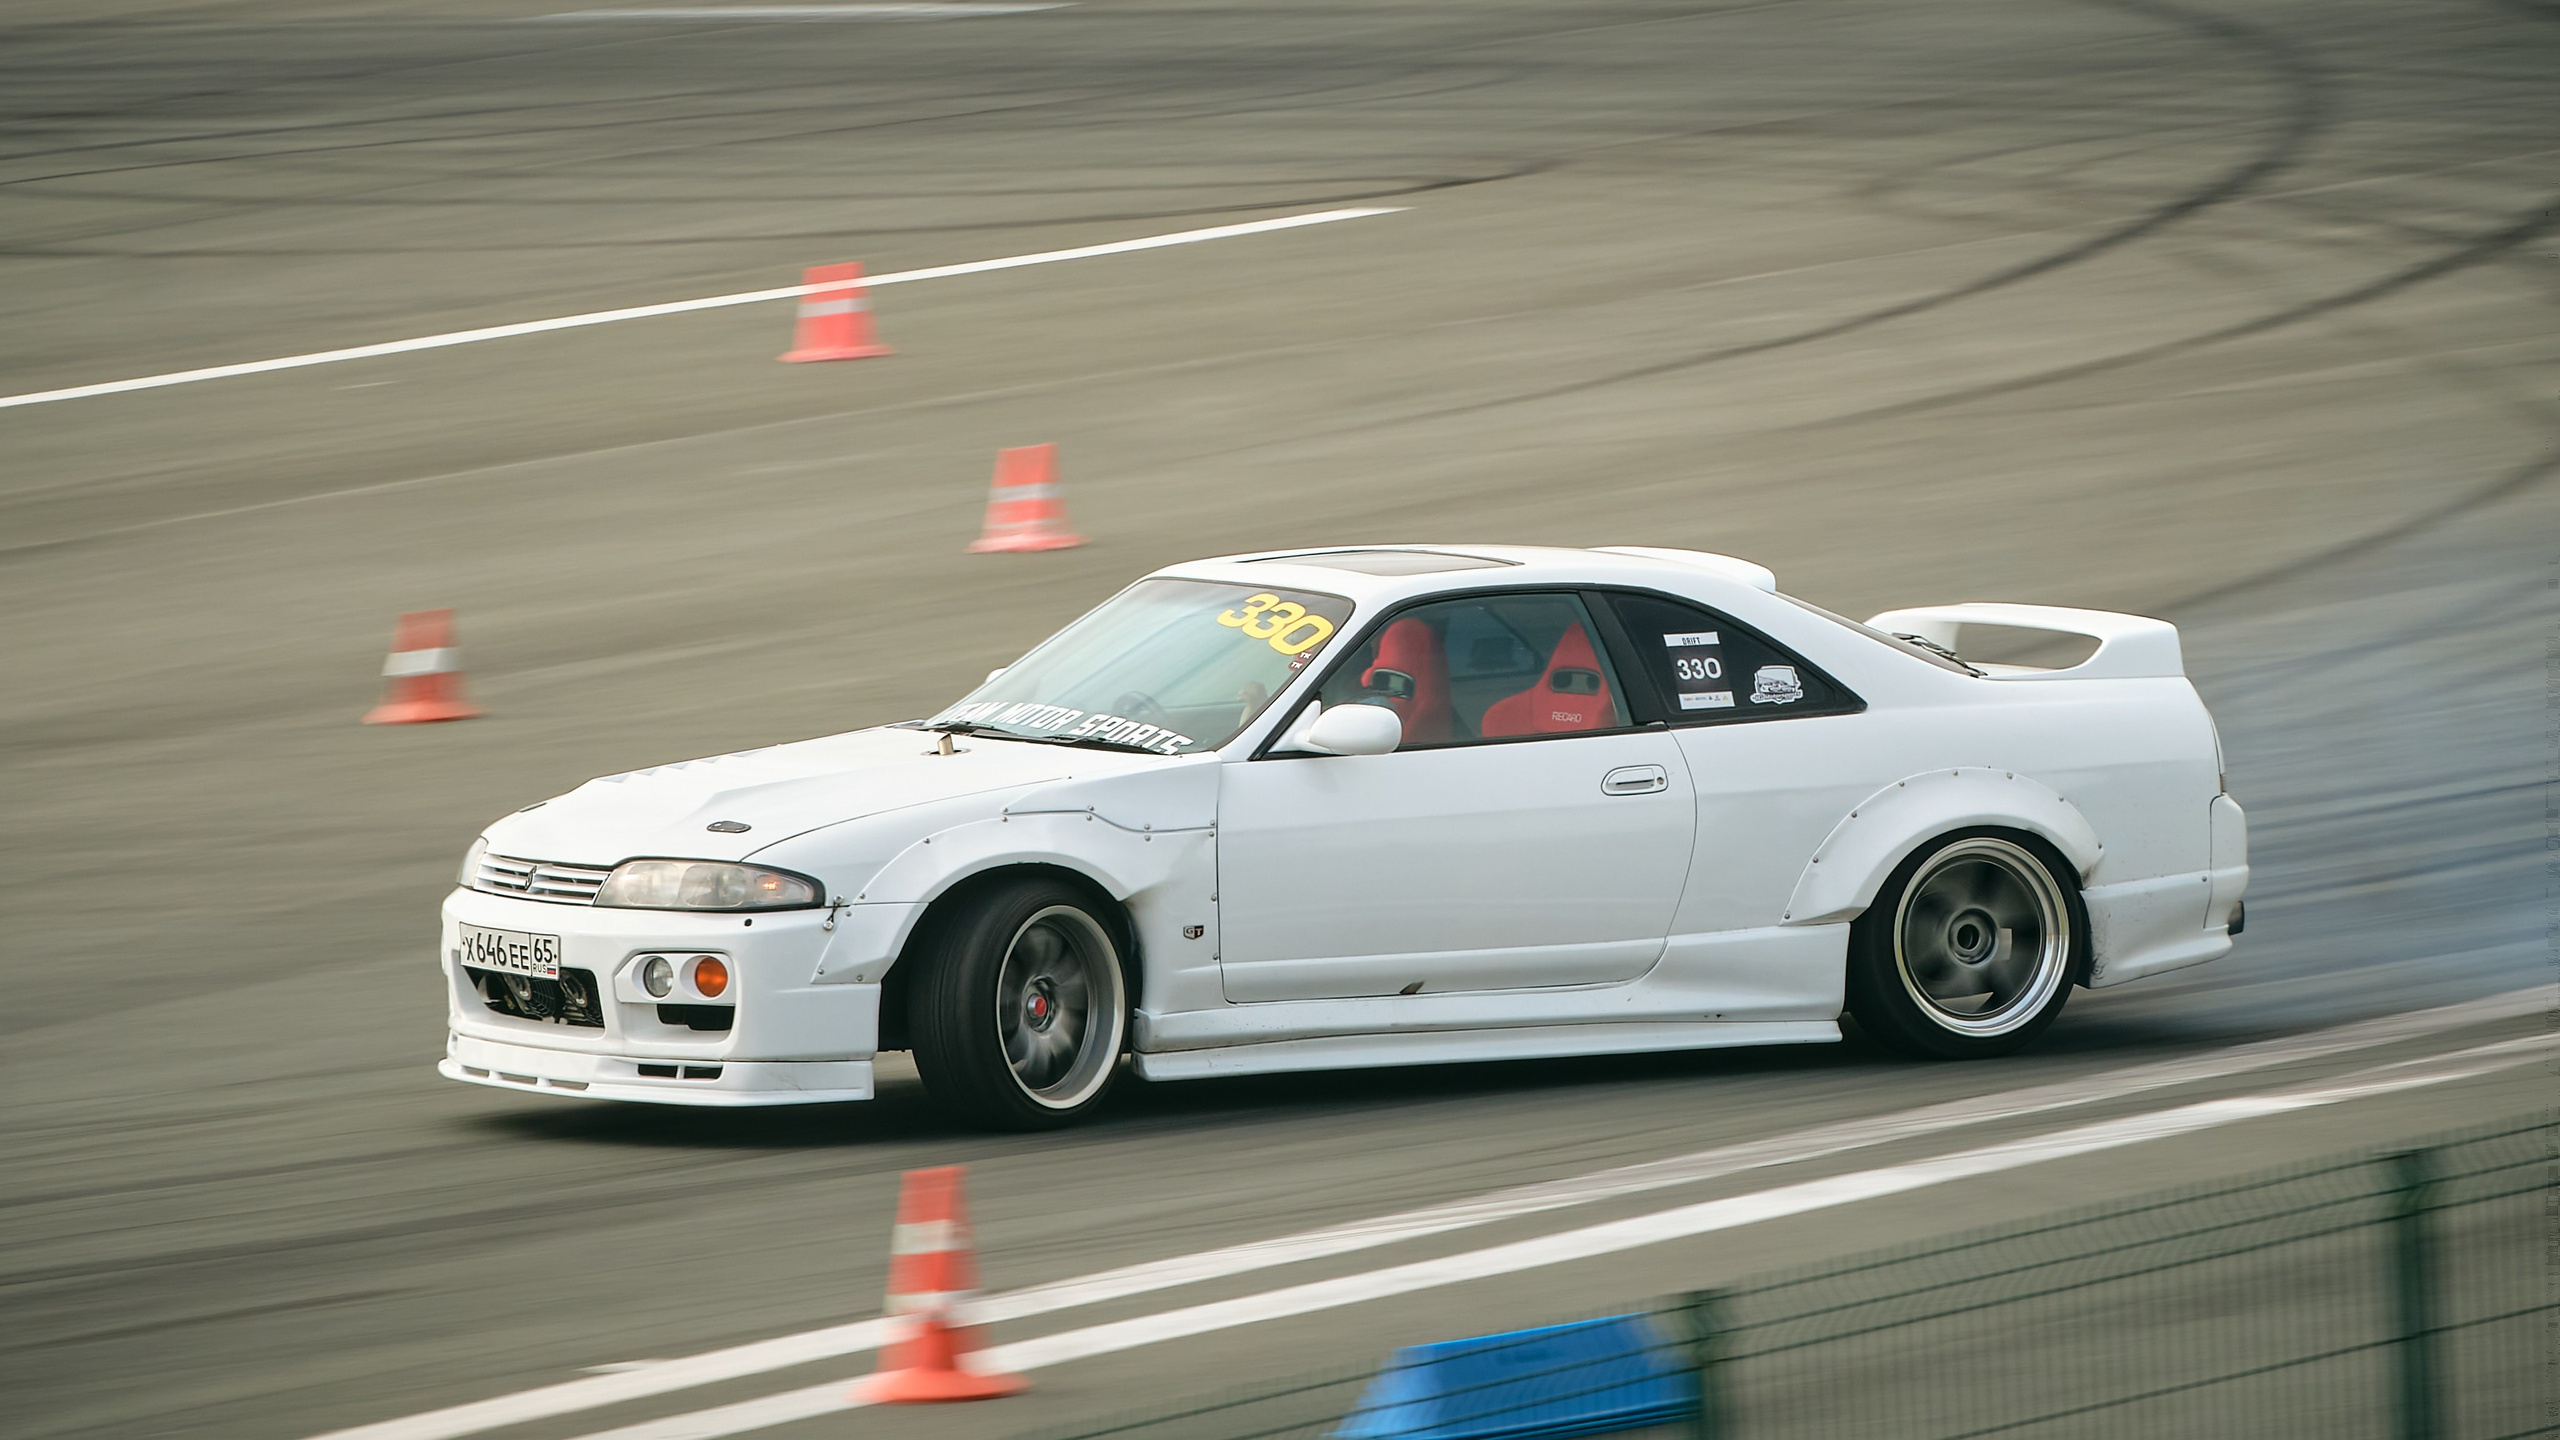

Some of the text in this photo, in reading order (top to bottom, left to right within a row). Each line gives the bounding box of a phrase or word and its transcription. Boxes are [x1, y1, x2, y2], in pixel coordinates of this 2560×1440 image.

[1216, 592, 1334, 656] 330
[1677, 657, 1722, 680] 330
[988, 702, 1085, 732] MOTOR
[1067, 713, 1195, 755] SPORTS
[1551, 711, 1582, 723] RECARO
[534, 938, 553, 964] 65
[533, 963, 547, 974] RUS
